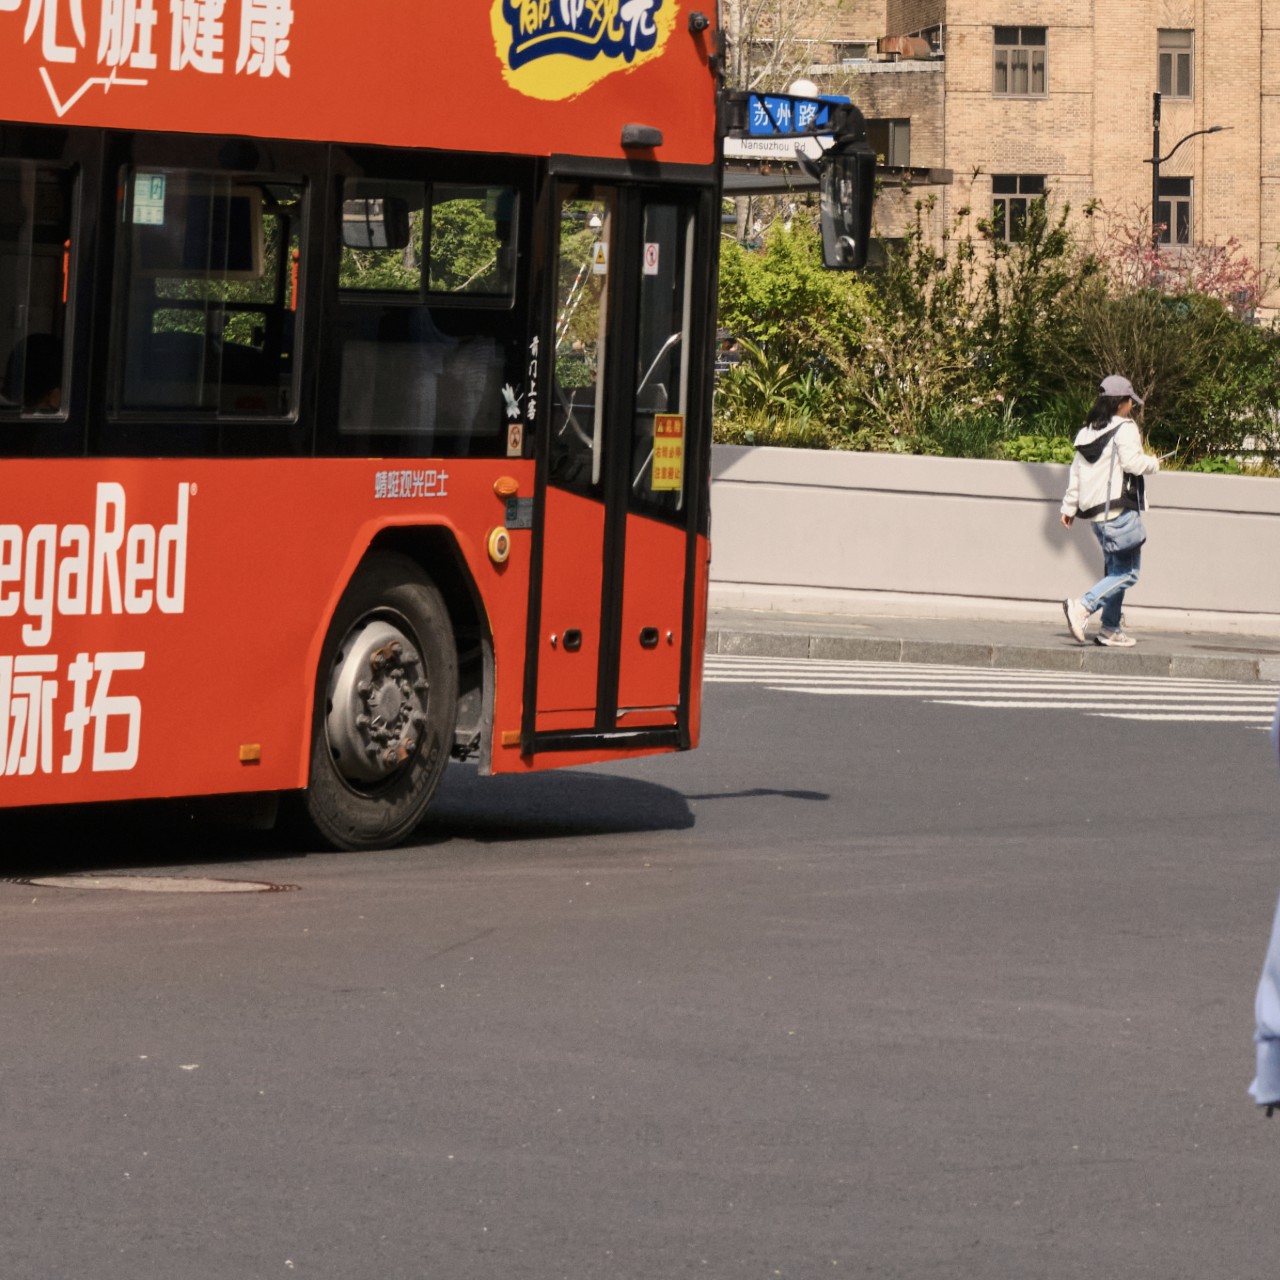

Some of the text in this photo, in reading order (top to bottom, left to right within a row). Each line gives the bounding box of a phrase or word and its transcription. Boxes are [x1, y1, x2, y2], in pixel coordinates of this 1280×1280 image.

[741, 139, 789, 152] Nansuzhou
[374, 469, 449, 499] 蜻蜓观光巴士
